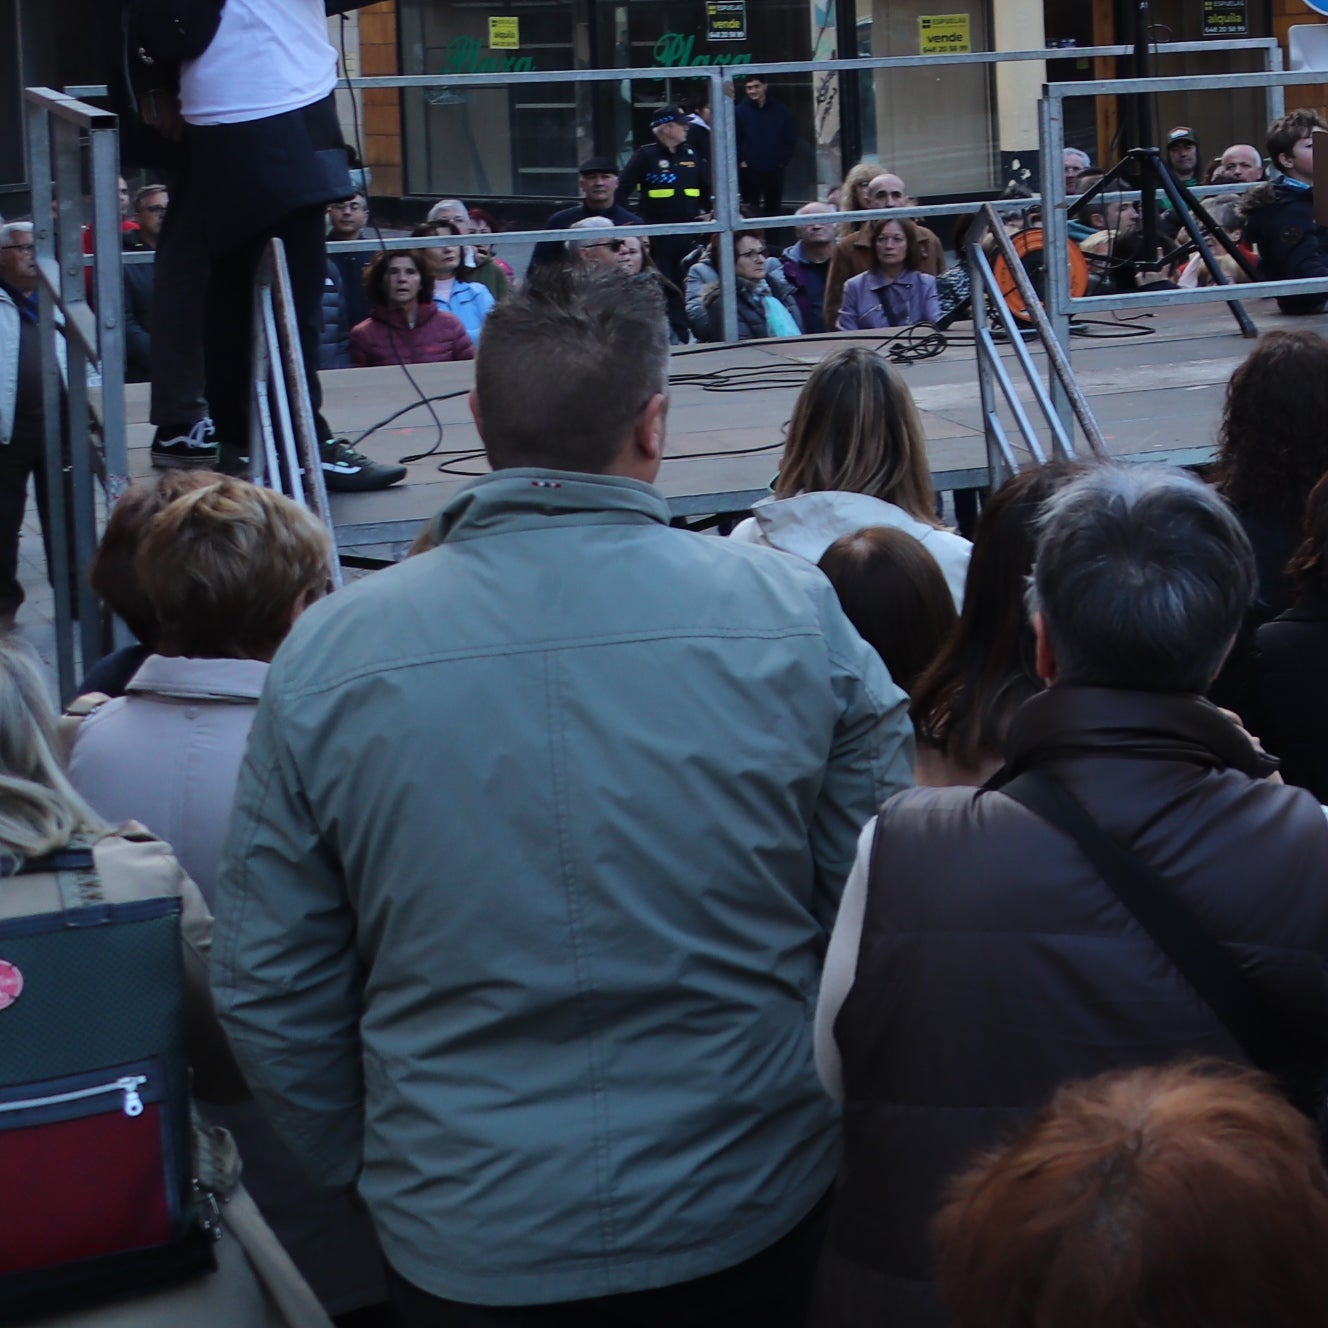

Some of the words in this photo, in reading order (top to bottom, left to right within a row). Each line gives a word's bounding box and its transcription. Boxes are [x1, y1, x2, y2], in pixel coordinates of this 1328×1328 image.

[712, 18, 741, 29] vende
[1207, 13, 1242, 24] alquila
[927, 33, 964, 43] vende
[653, 33, 752, 80] Plaza
